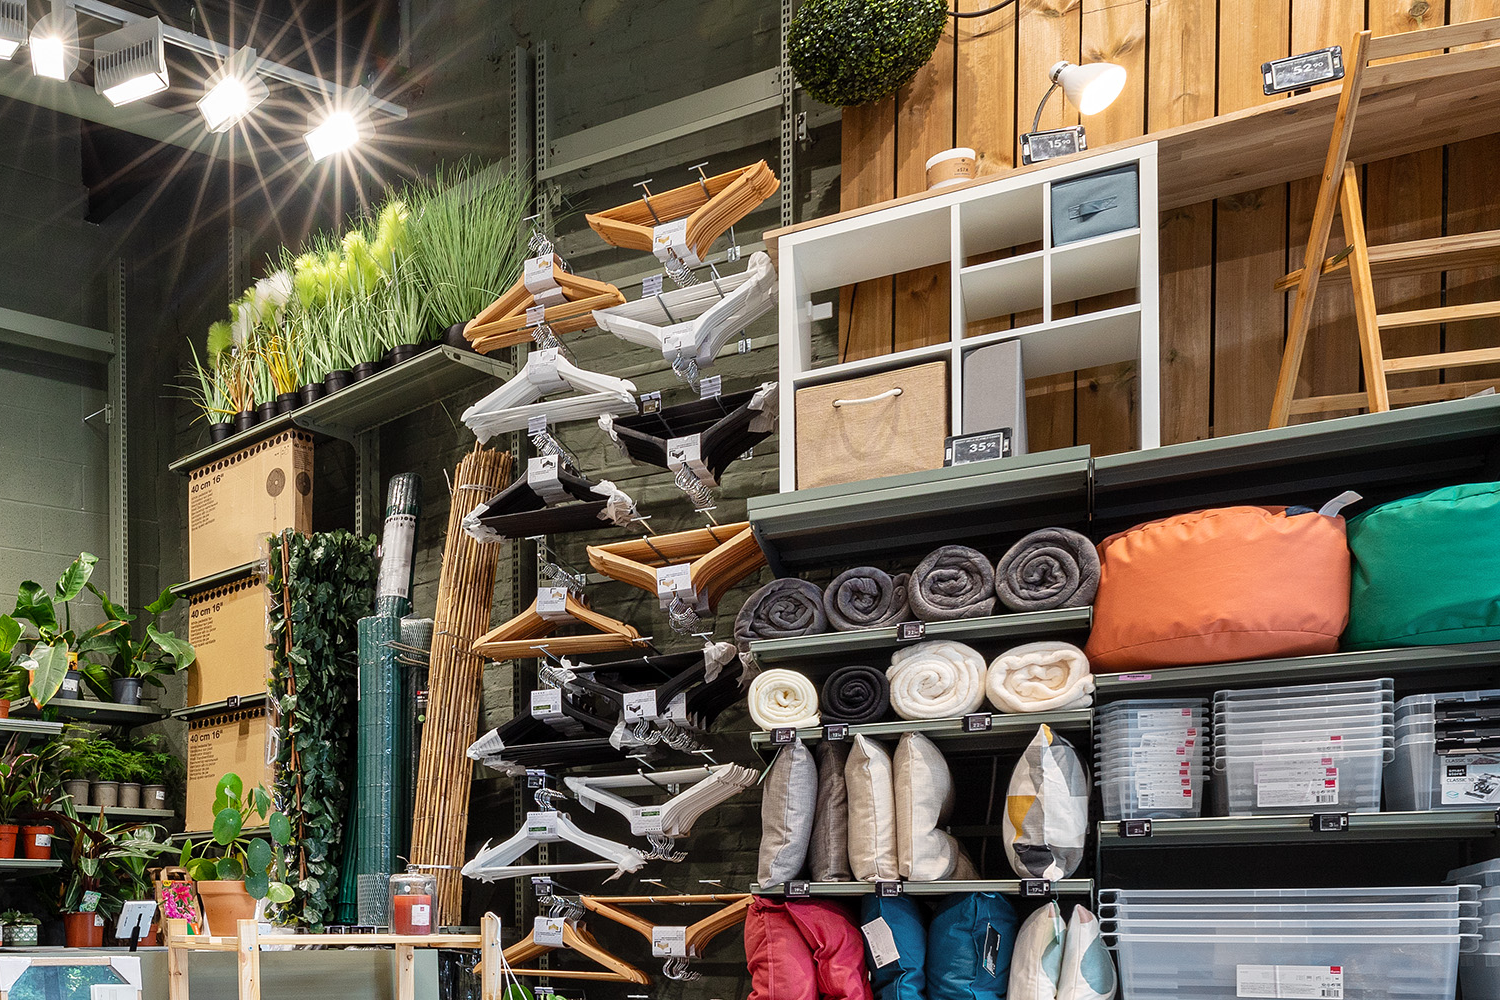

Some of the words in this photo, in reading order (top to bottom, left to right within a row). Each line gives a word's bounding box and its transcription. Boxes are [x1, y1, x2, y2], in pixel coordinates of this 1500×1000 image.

[191, 484, 199, 494] 40
[201, 481, 211, 490] cm
[191, 610, 199, 618] 40
[200, 607, 210, 617] cm
[190, 734, 198, 742] 40
[200, 733, 210, 742] cm
